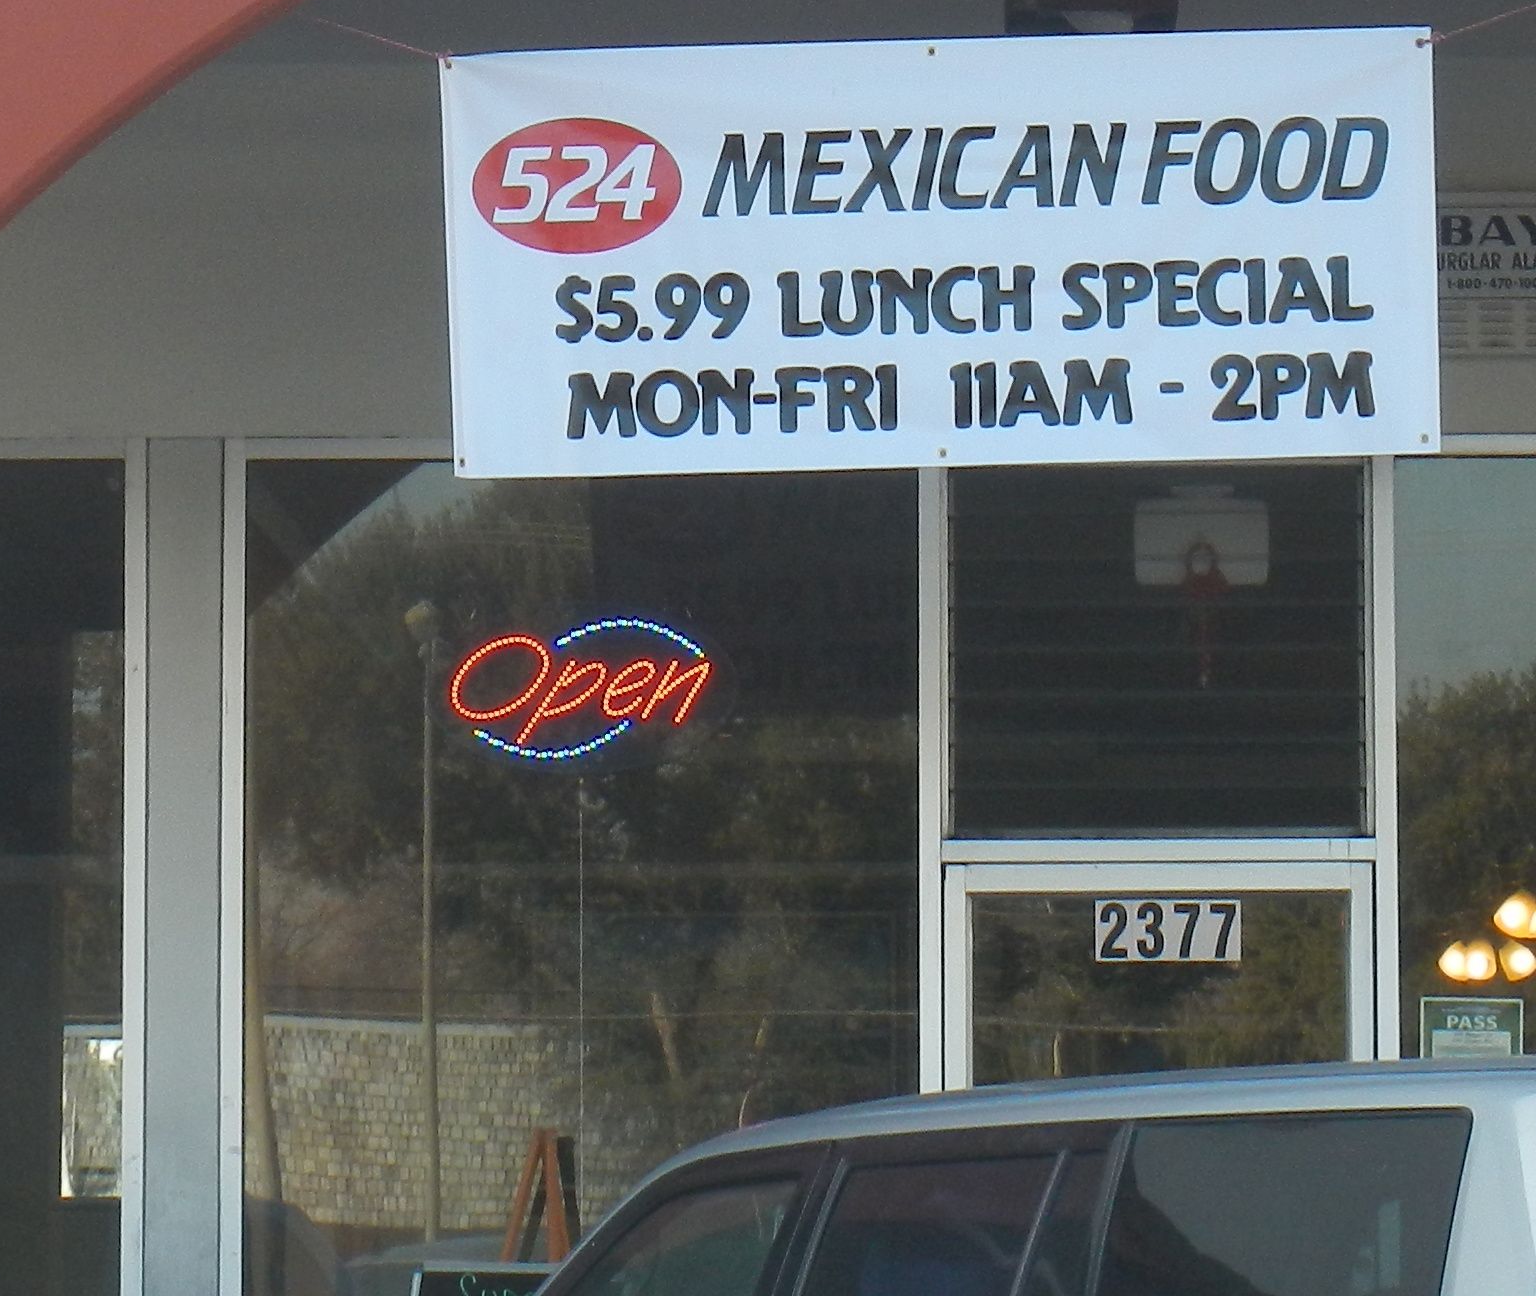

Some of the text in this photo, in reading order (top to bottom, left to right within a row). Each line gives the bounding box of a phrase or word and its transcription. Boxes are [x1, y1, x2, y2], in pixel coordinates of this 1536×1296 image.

[493, 115, 1390, 224] 524 MEXICAN FOOD
[554, 272, 751, 344] $5.99
[776, 265, 1037, 338] LUNCH
[1061, 255, 1374, 332] SPECIAL
[1437, 252, 1502, 271] URGLAR
[566, 363, 899, 440] MON-FRI
[948, 357, 1133, 429] 11AM
[1209, 350, 1376, 422] 2PM
[450, 634, 713, 746] Open
[1099, 902, 1237, 960] 2377
[1446, 1014, 1498, 1031] PASS
